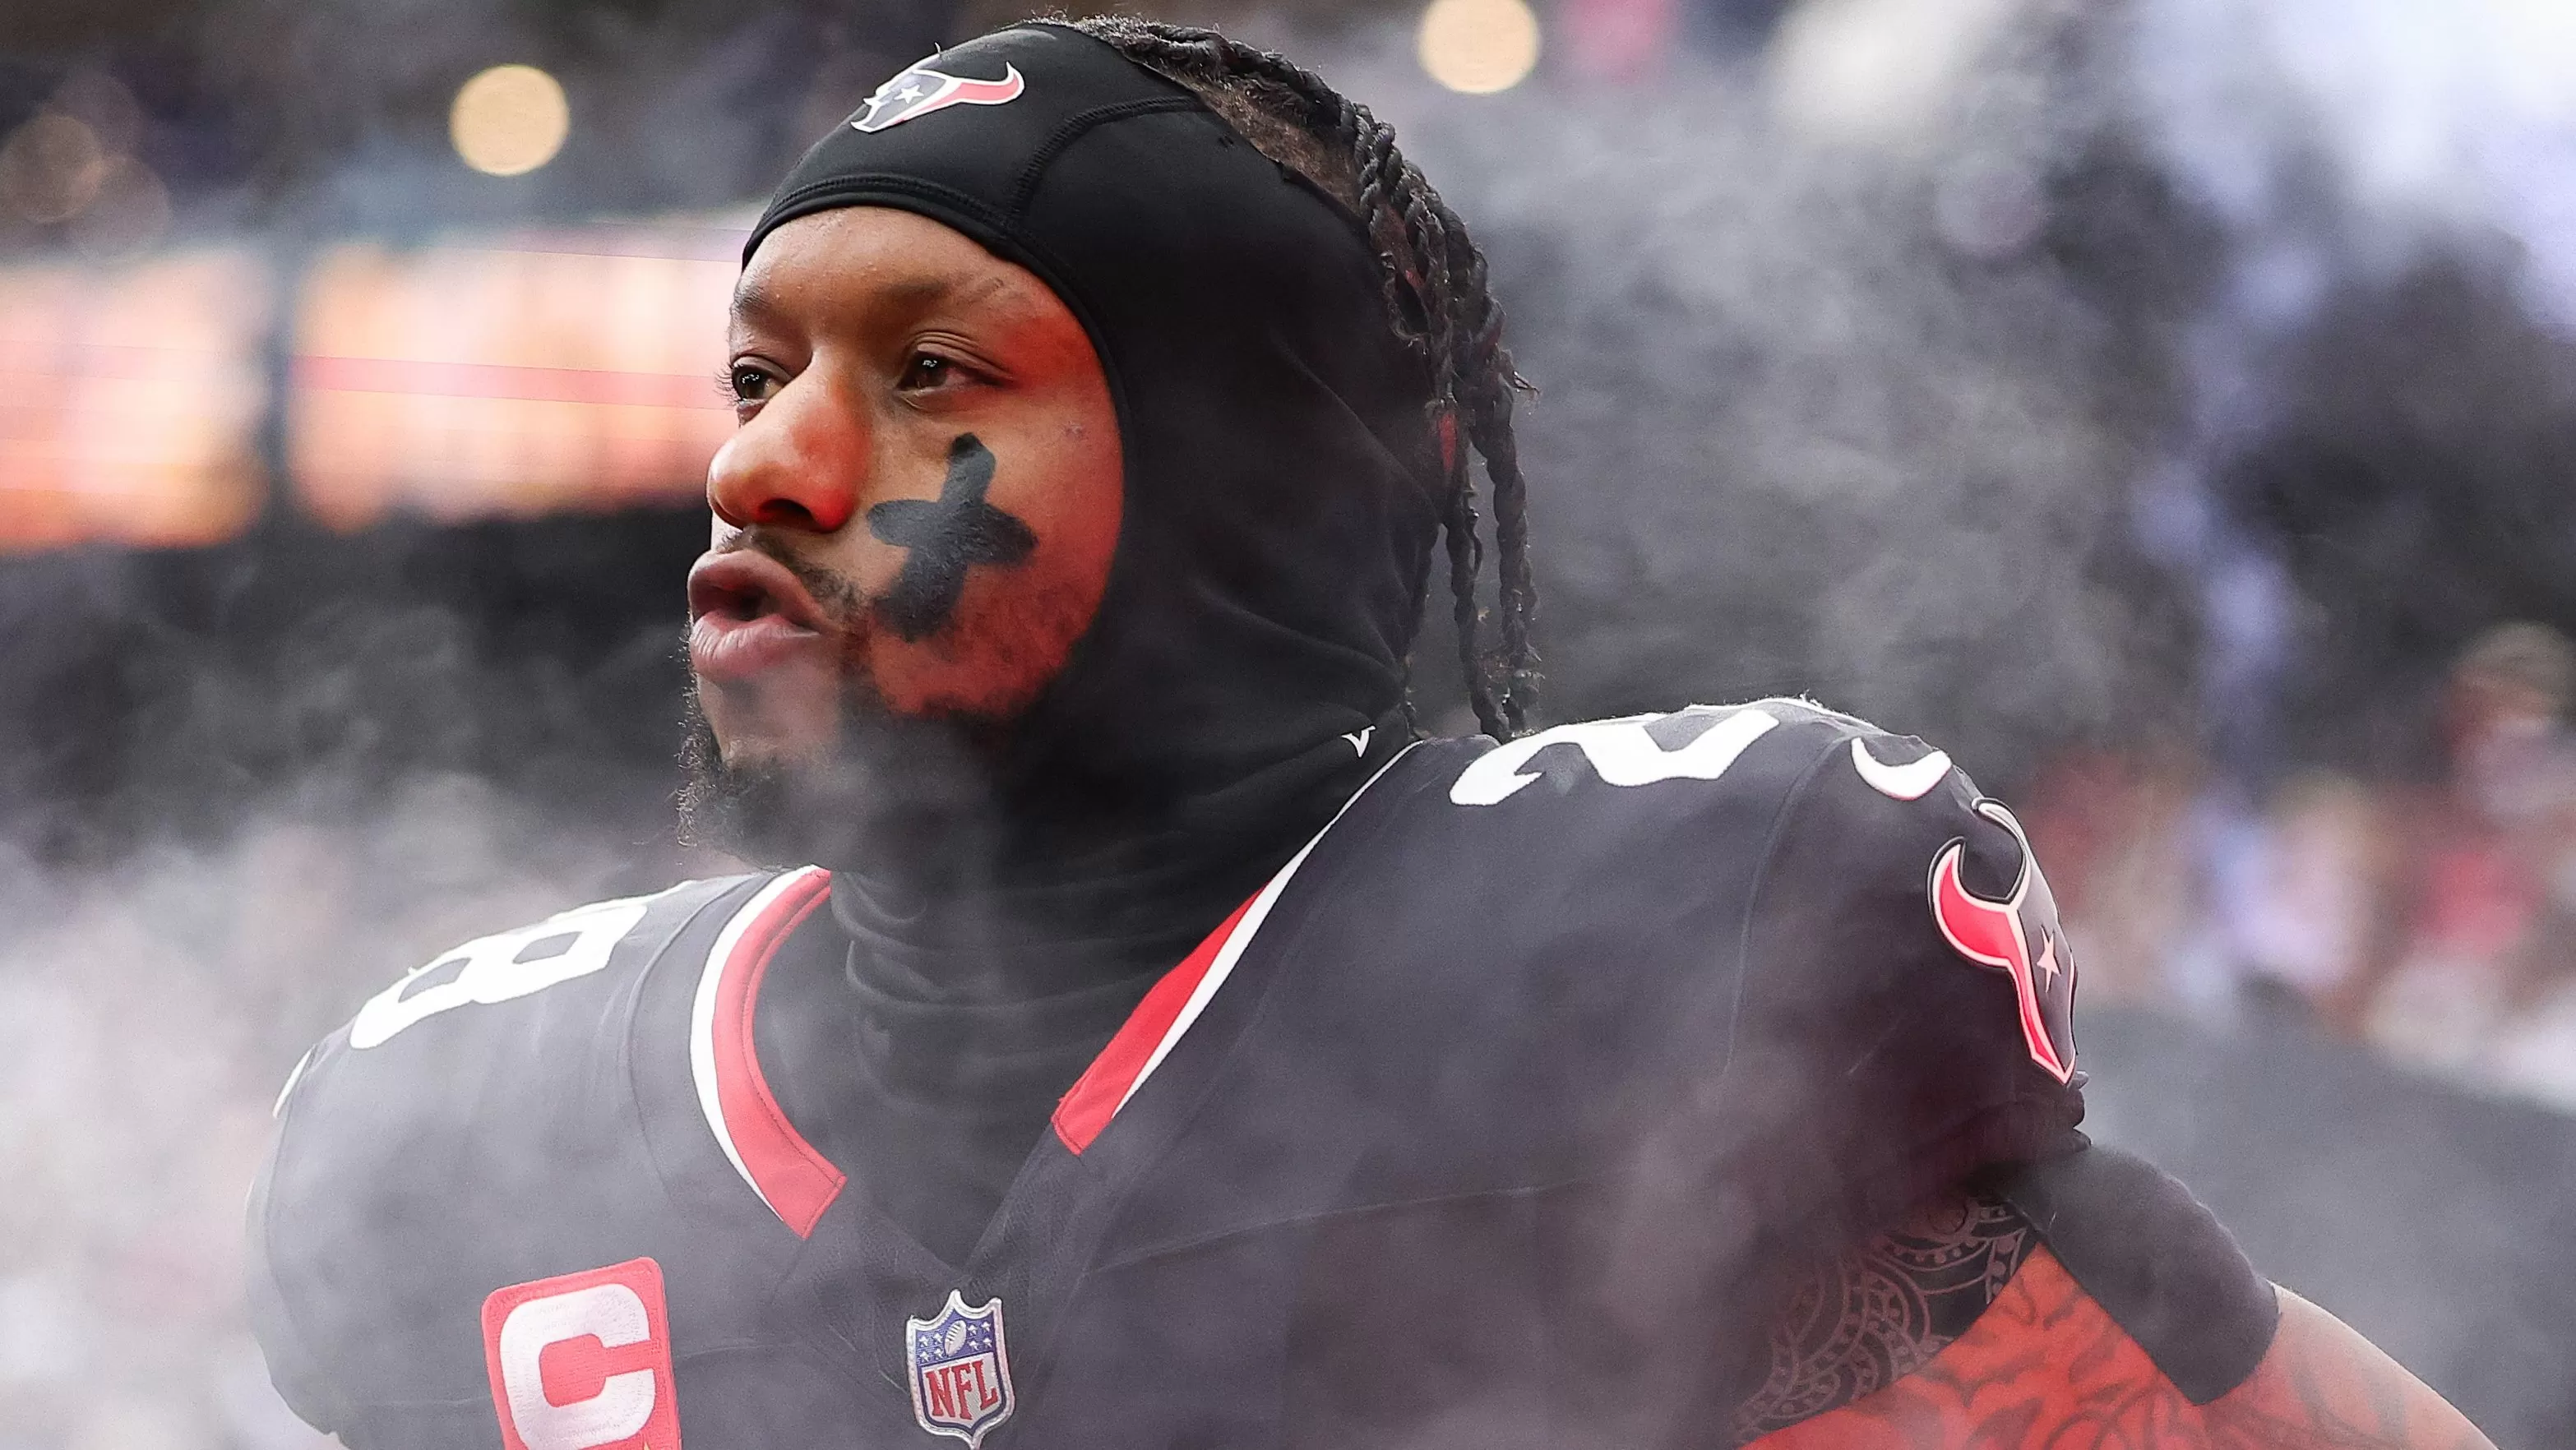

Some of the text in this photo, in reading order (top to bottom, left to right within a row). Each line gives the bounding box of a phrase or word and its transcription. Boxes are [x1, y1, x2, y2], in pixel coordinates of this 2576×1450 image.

[349, 903, 648, 1050] 8
[500, 1283, 656, 1450] C
[924, 1360, 999, 1420] NFL
